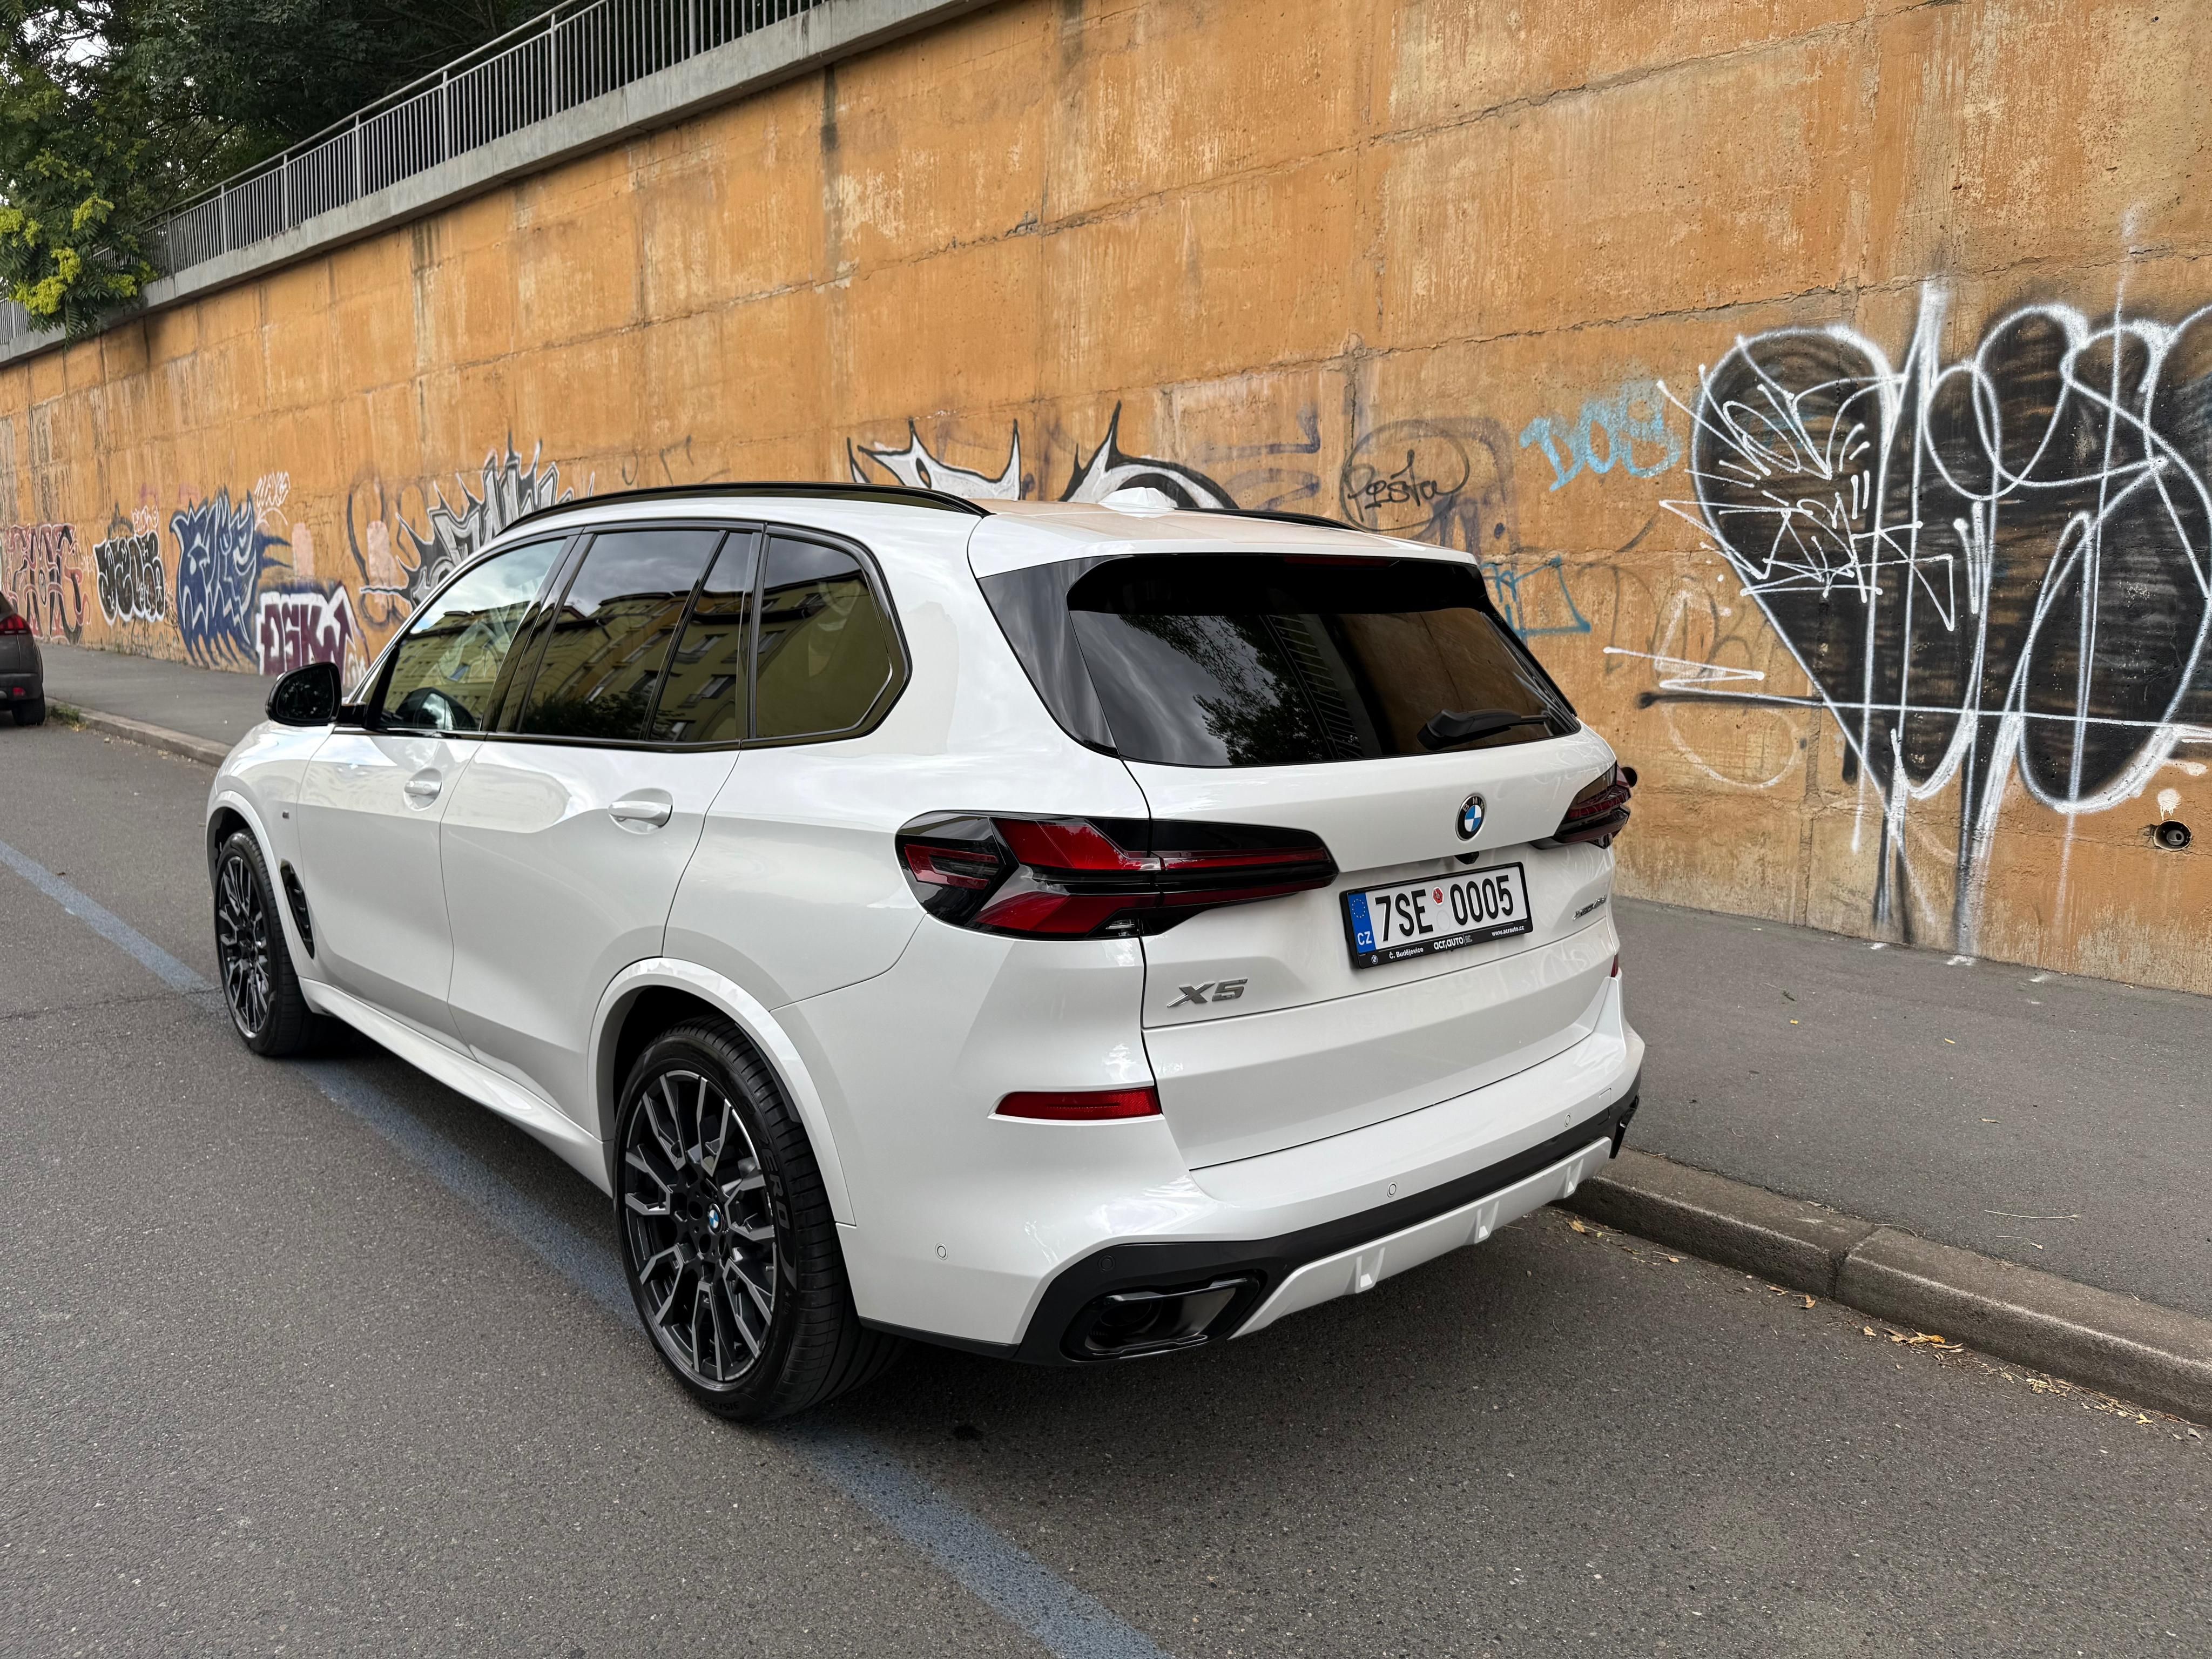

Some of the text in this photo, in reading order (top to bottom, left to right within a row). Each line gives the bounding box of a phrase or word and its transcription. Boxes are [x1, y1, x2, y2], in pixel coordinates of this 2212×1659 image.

[1374, 889, 1433, 942] 7SE
[1450, 875, 1514, 926] 0005
[1357, 930, 1372, 946] CZ
[1166, 976, 1249, 1008] X5
